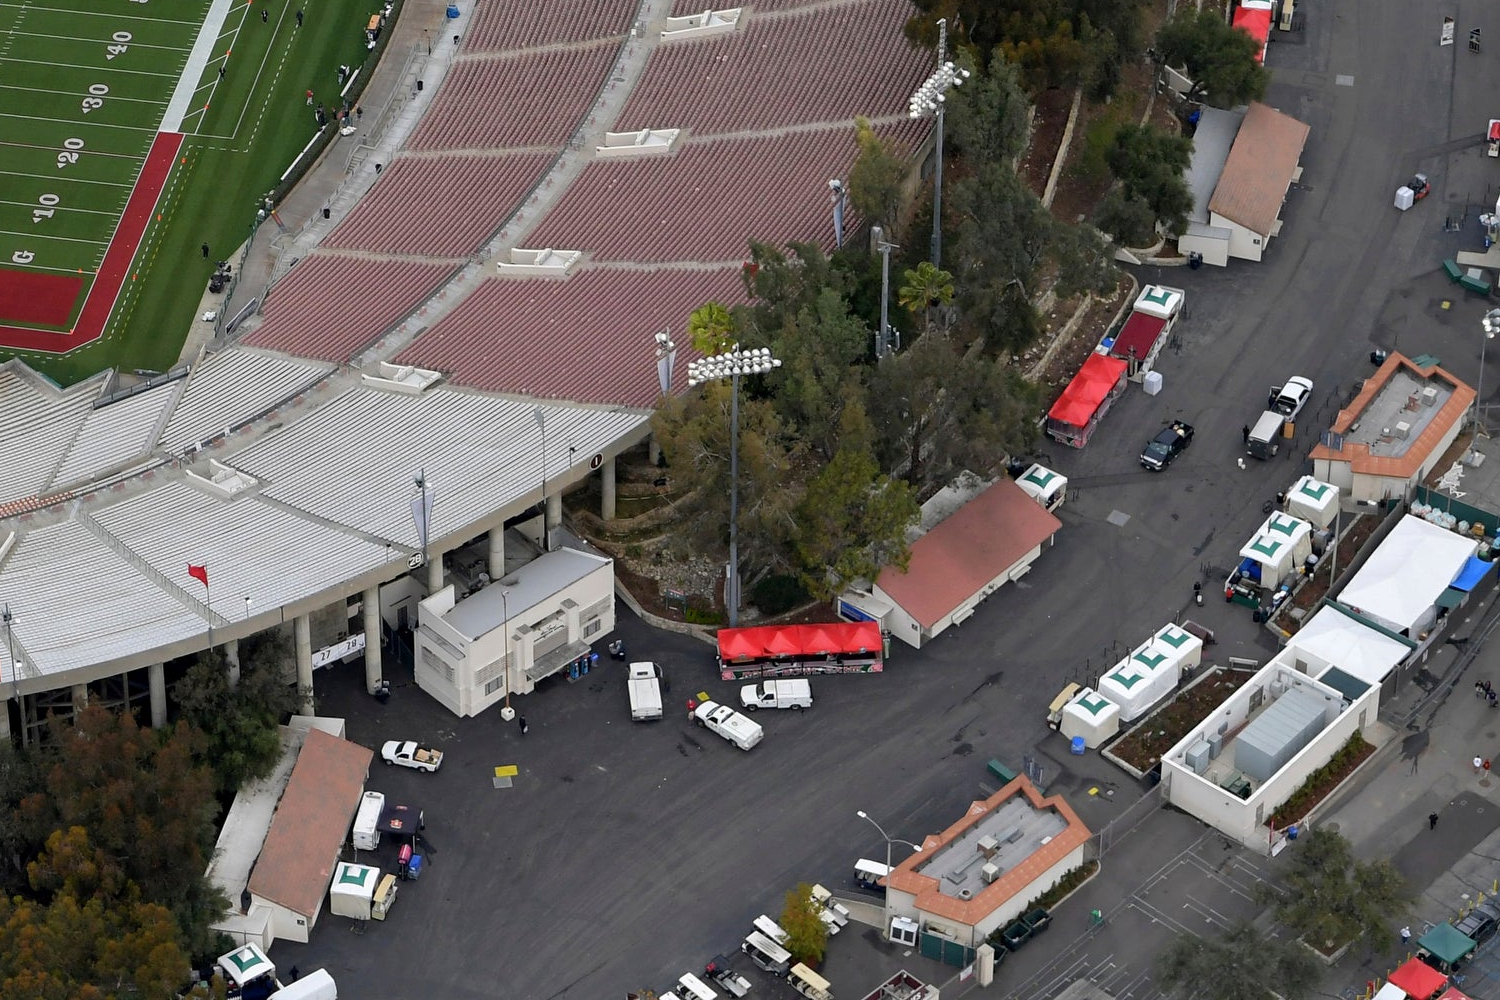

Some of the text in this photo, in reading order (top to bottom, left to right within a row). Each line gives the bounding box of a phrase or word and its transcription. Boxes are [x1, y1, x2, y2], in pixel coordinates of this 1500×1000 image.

[107, 31, 132, 54] 40
[82, 83, 109, 109] 30
[58, 138, 84, 164] 20
[35, 193, 59, 219] 10
[11, 250, 35, 263] G
